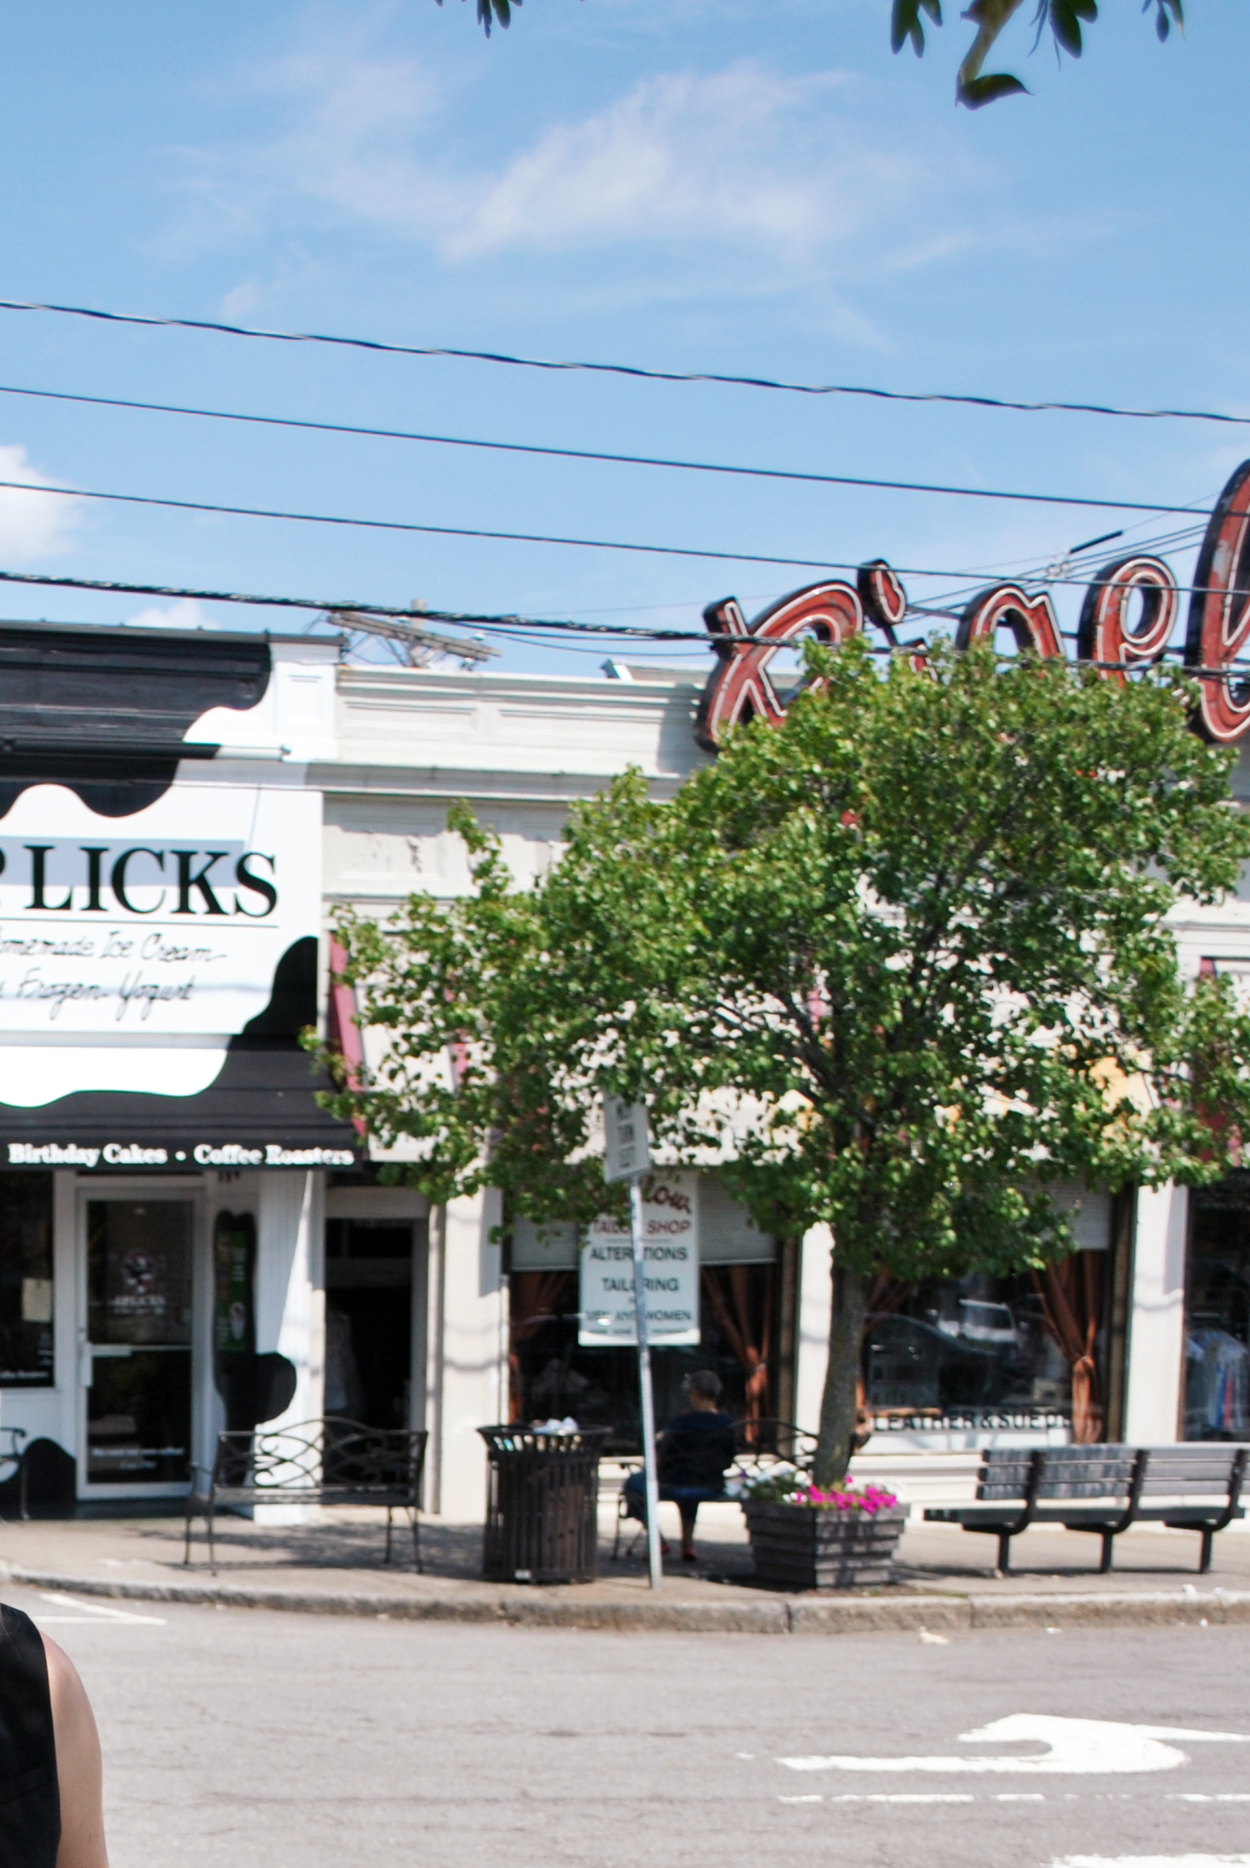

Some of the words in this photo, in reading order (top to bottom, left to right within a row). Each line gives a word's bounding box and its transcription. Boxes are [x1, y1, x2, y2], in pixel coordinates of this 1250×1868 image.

[23, 844, 279, 919] LICKS
[99, 930, 134, 959] Ice
[140, 932, 228, 963] Cream
[16, 966, 109, 1021] Frozen
[117, 970, 197, 1022] Yogurt
[7, 1143, 100, 1169] Birthday
[101, 1143, 169, 1165] Cakes
[192, 1143, 263, 1166] Coffee
[264, 1144, 355, 1166] Roasters
[647, 1220, 691, 1235] SHOP
[590, 1246, 688, 1261] ALTERTIONS
